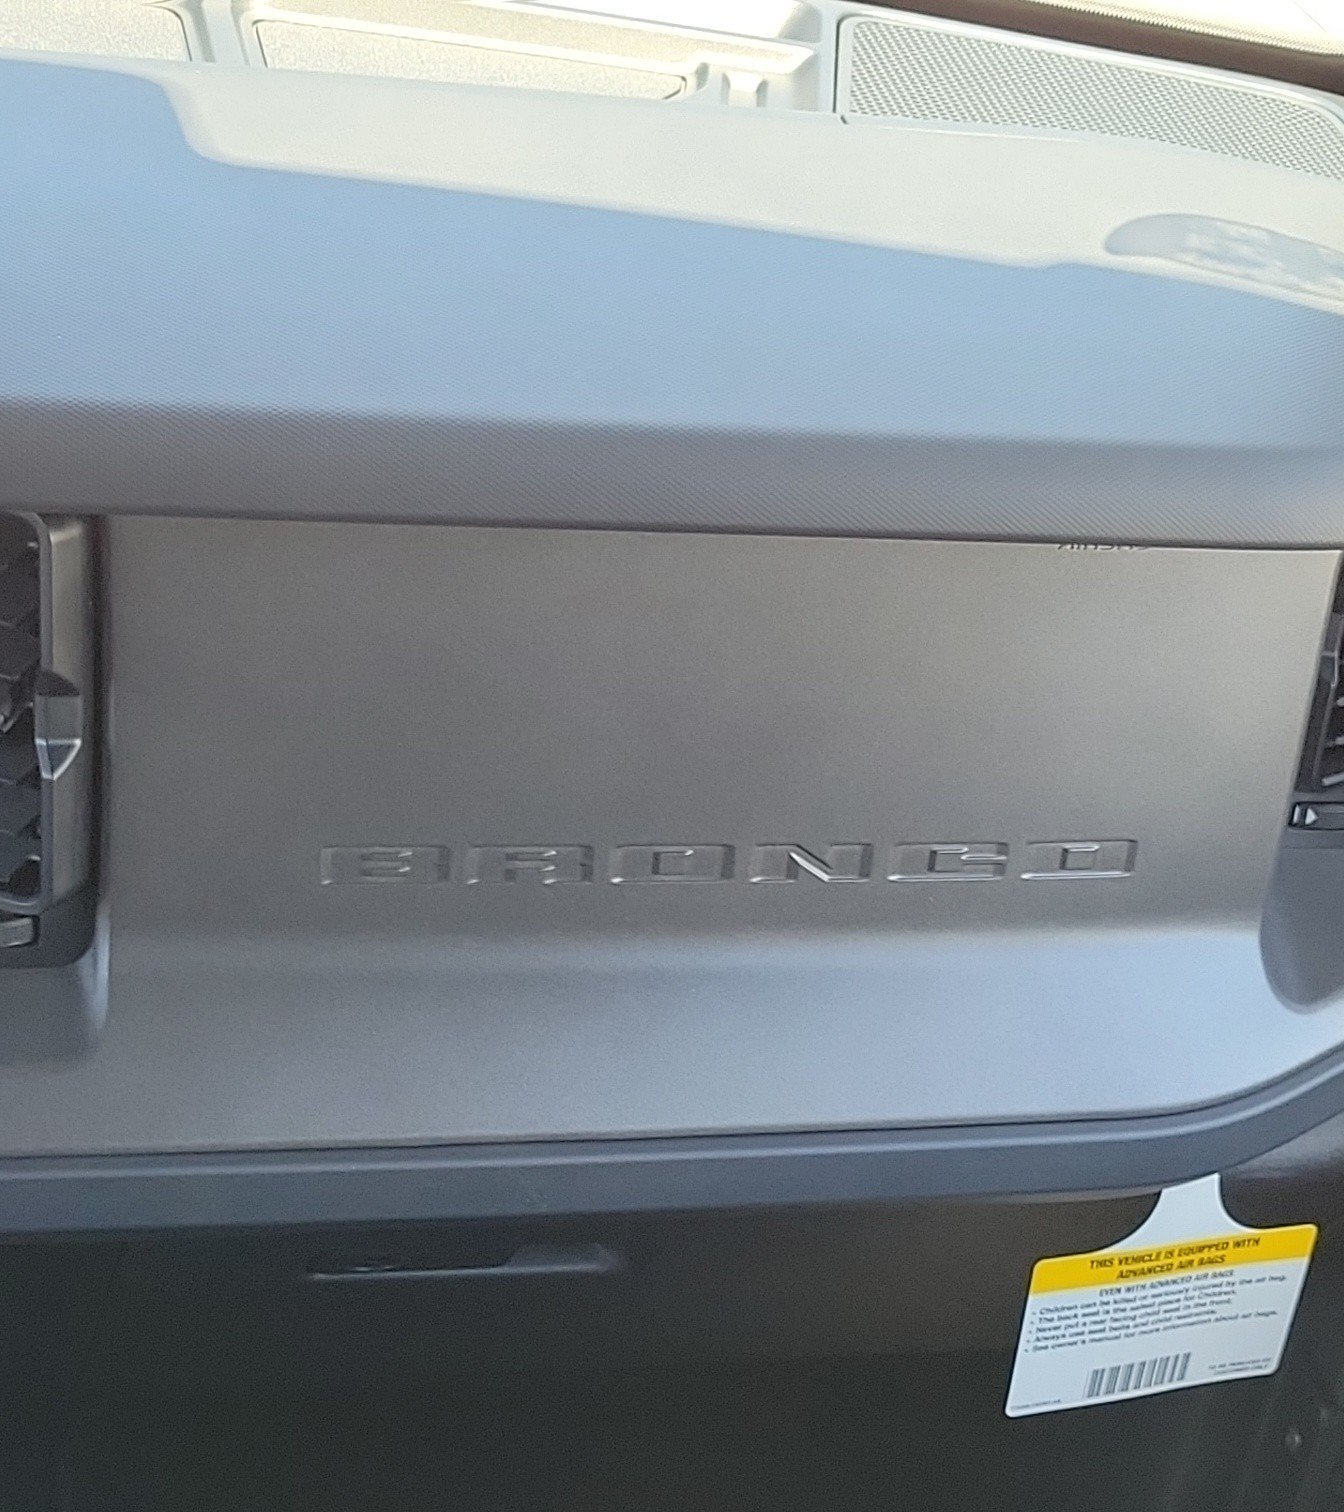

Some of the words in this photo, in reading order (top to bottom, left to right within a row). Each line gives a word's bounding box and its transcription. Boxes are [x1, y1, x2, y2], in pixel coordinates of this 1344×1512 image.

[319, 838, 1140, 886] BRONCO
[1088, 1257, 1114, 1269] THIS
[1117, 1250, 1162, 1265] VEHICLE
[1163, 1249, 1174, 1259] IS
[1232, 1237, 1260, 1249] WITH
[1116, 1262, 1174, 1278] ADVANCED
[1175, 1258, 1195, 1270] AIR
[1196, 1254, 1225, 1267] BAGS
